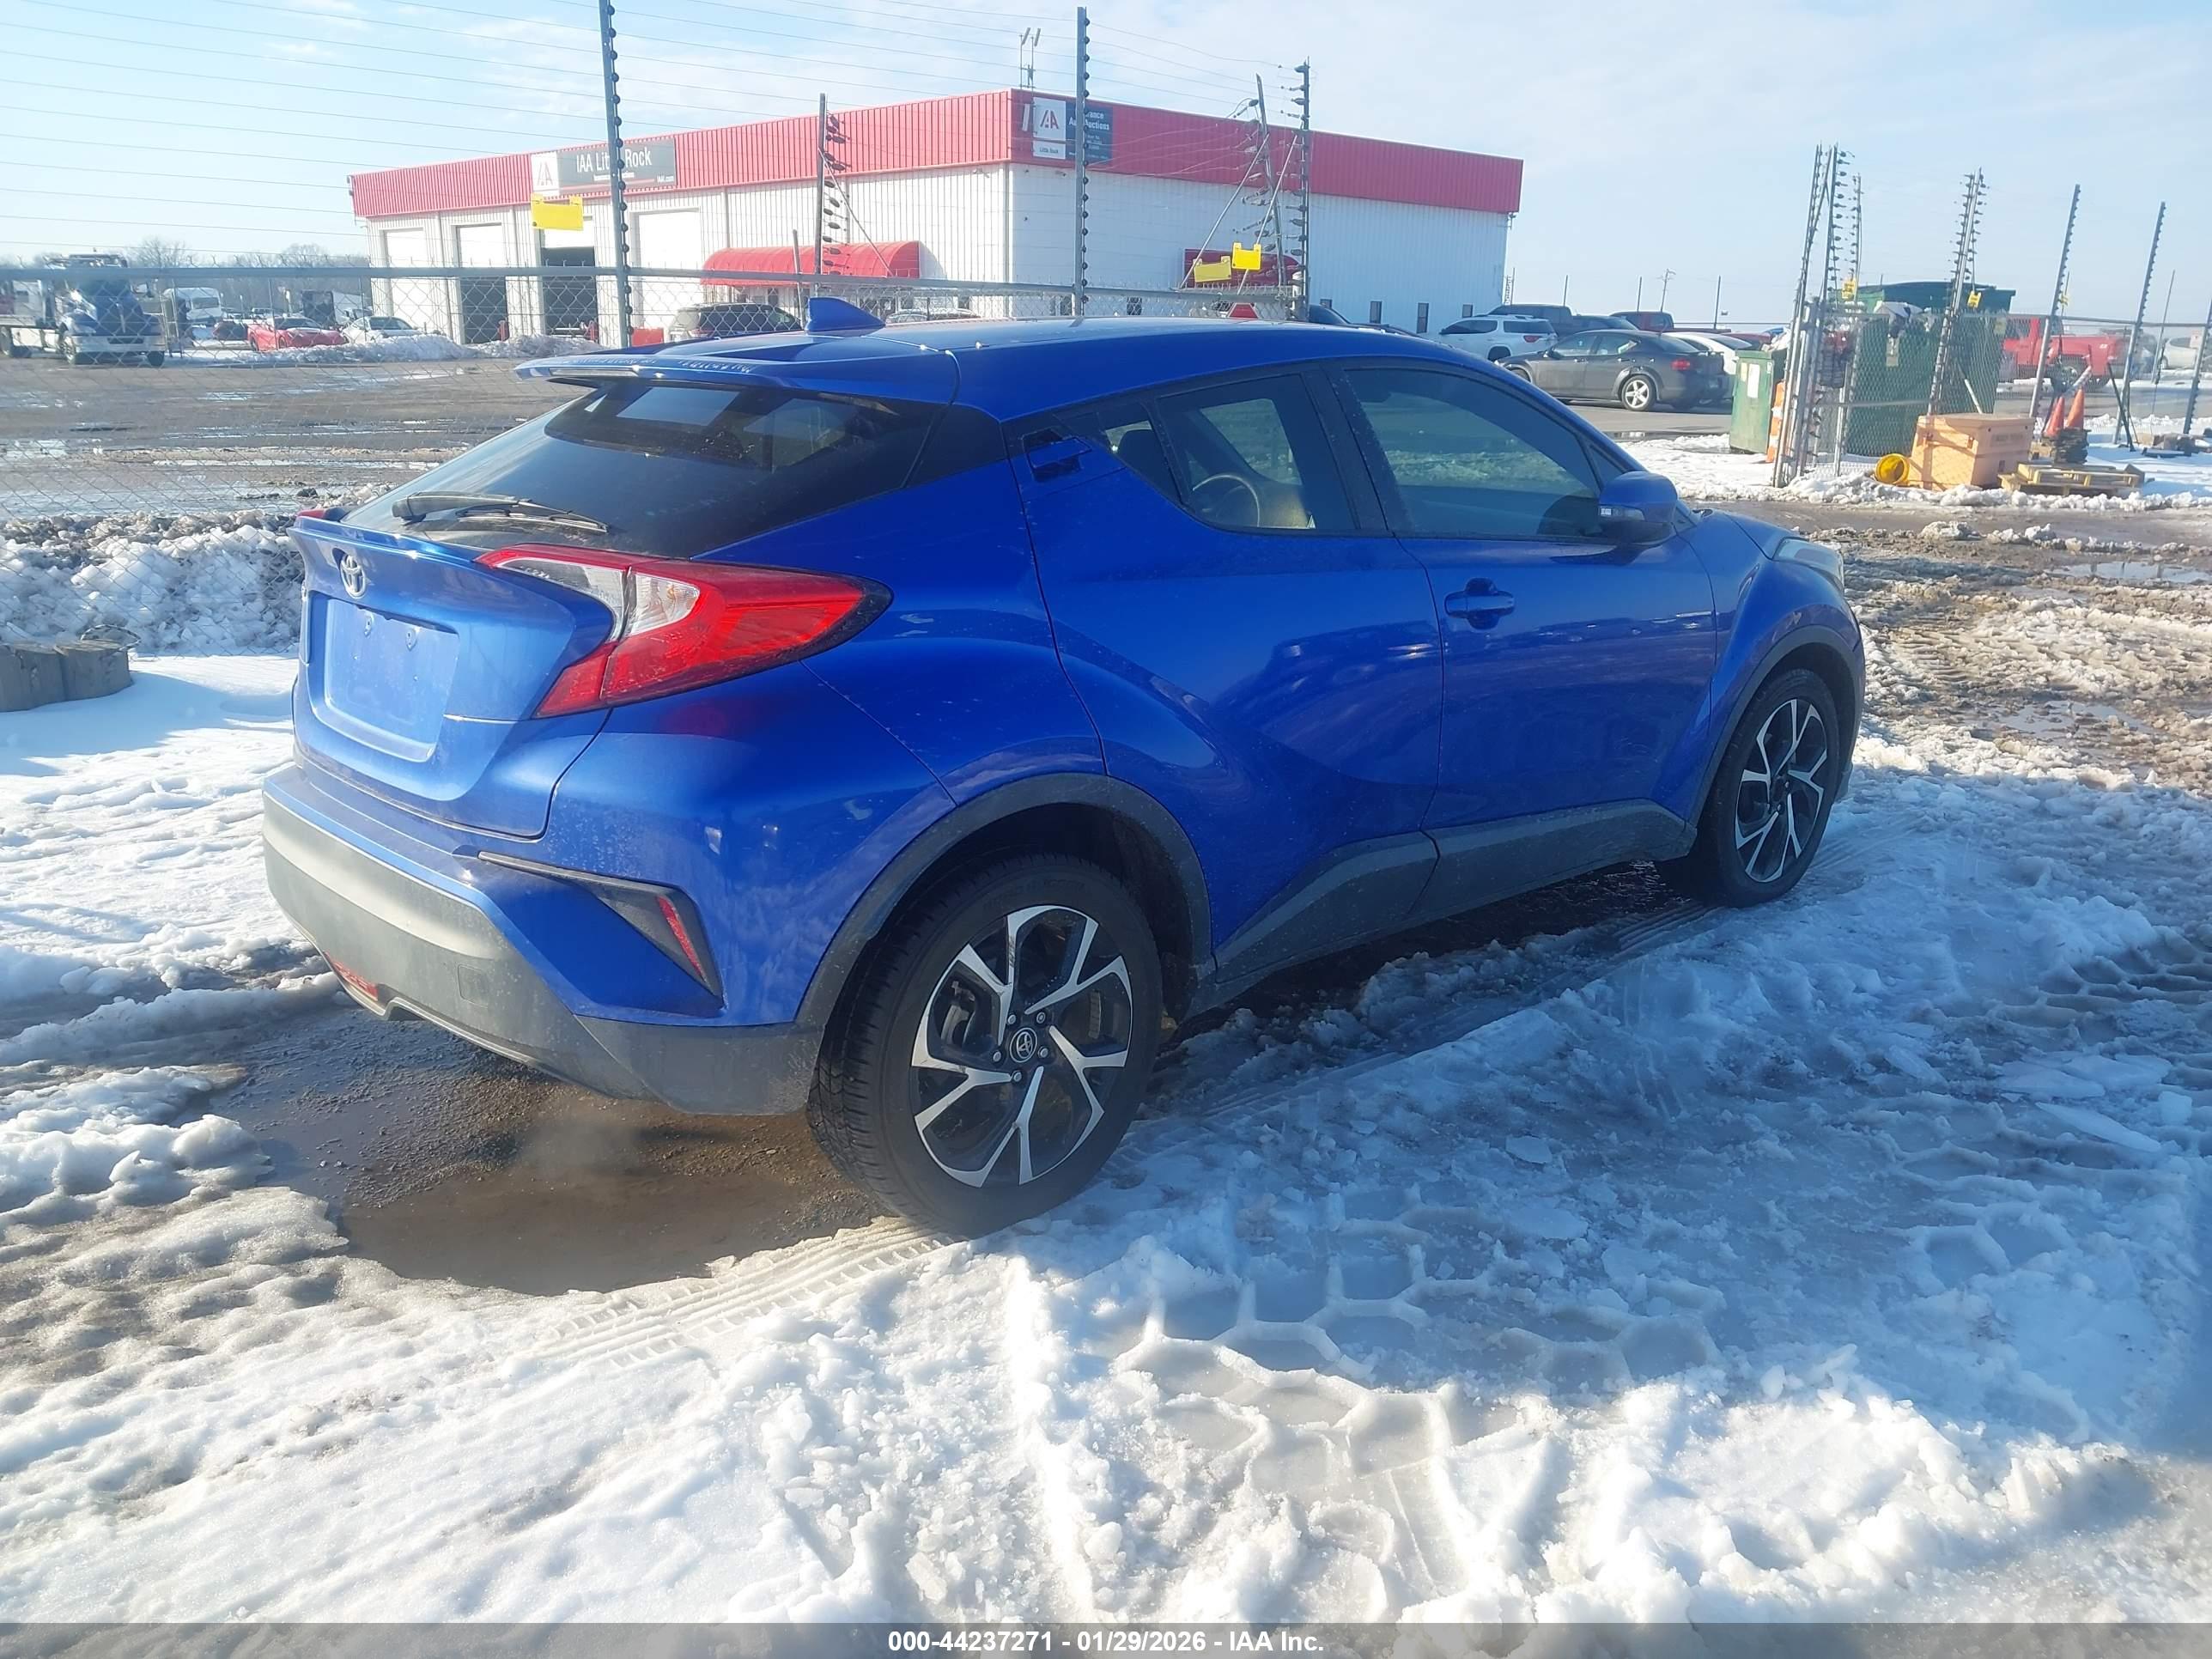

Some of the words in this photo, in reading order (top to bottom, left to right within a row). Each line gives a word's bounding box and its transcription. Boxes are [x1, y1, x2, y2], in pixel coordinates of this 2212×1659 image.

[576, 153, 593, 173] IAA
[595, 152, 611, 171] Lit
[624, 147, 653, 167] Rock
